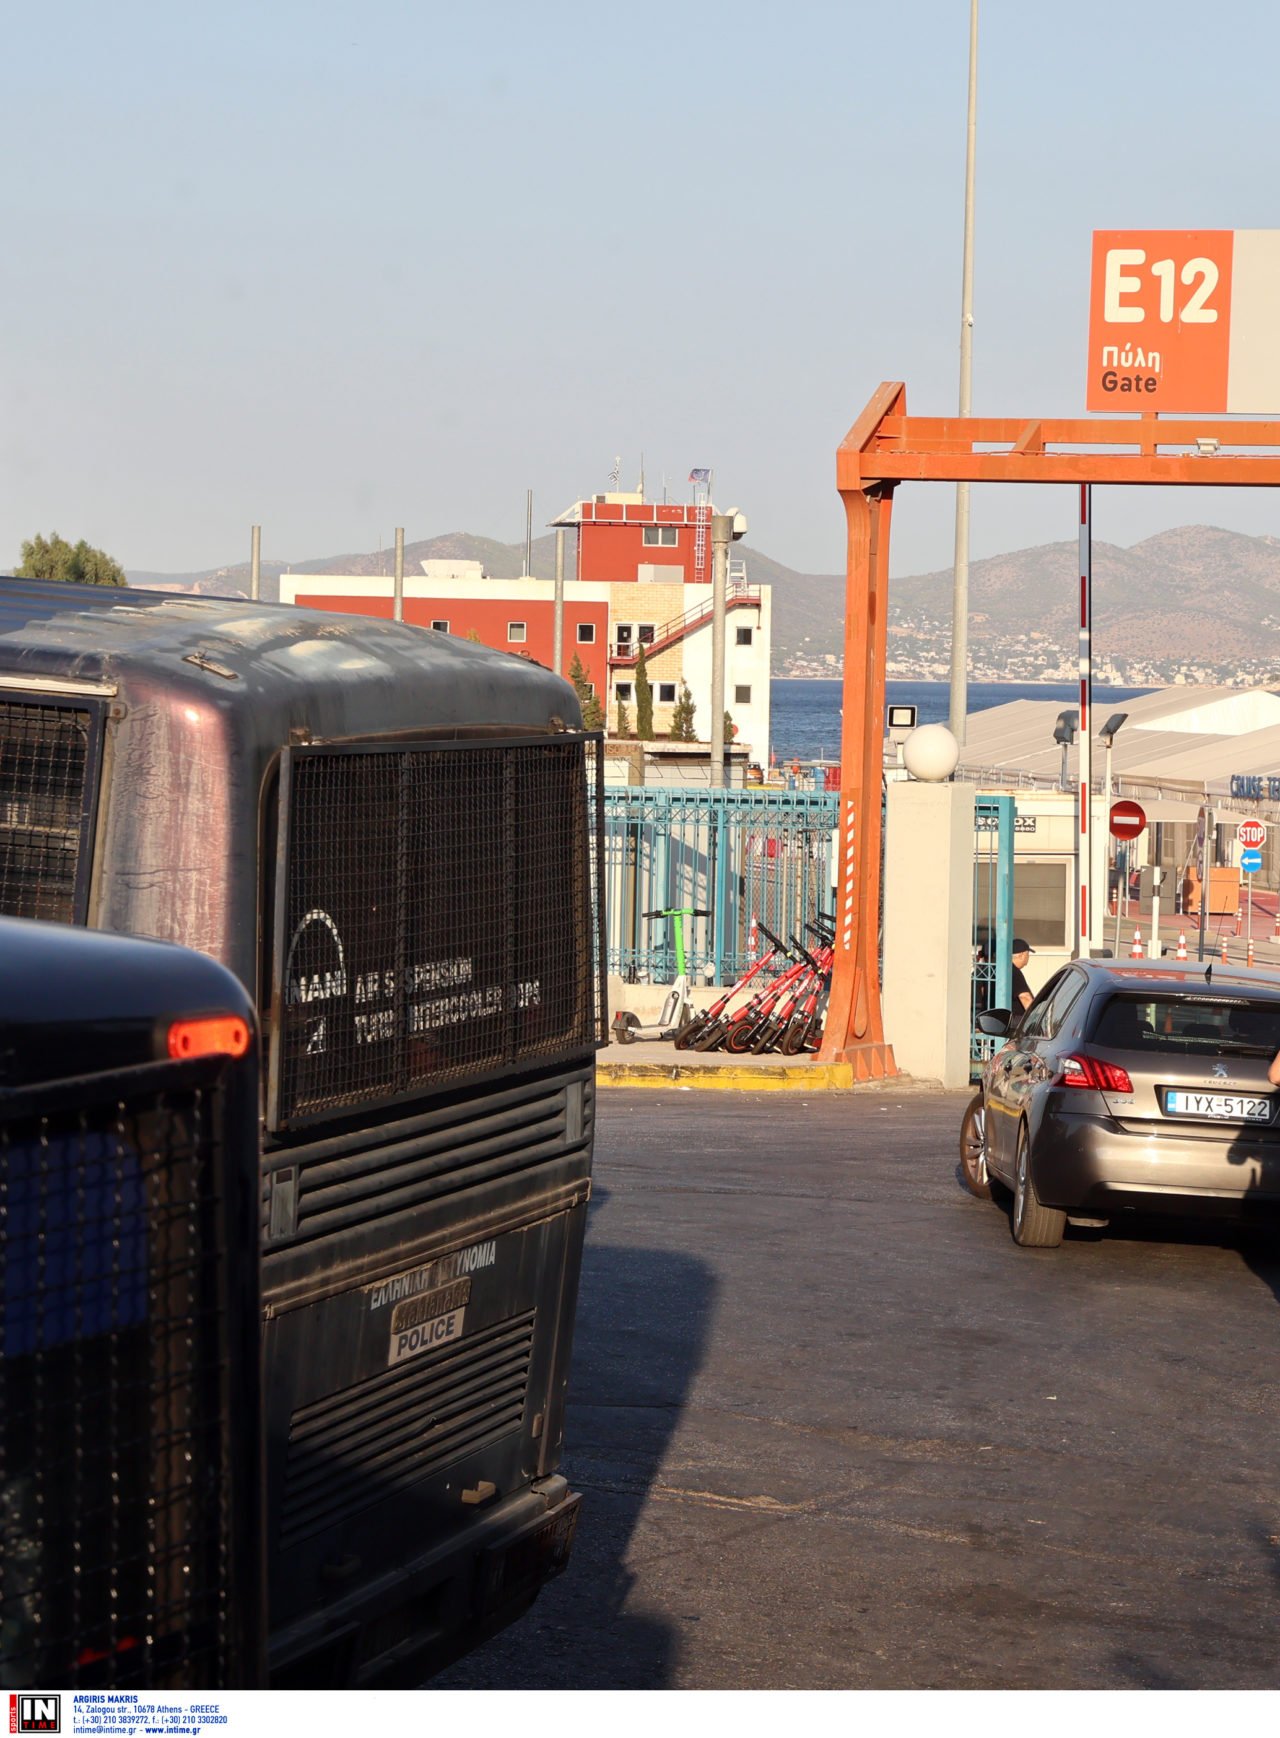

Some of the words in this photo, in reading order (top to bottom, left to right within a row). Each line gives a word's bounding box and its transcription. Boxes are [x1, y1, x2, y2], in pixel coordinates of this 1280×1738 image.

[1103, 248, 1220, 324] E12
[1102, 342, 1161, 374] Πύλη
[1101, 371, 1158, 394] Gate
[1239, 826, 1264, 842] STOP
[397, 1314, 456, 1357] POLICE
